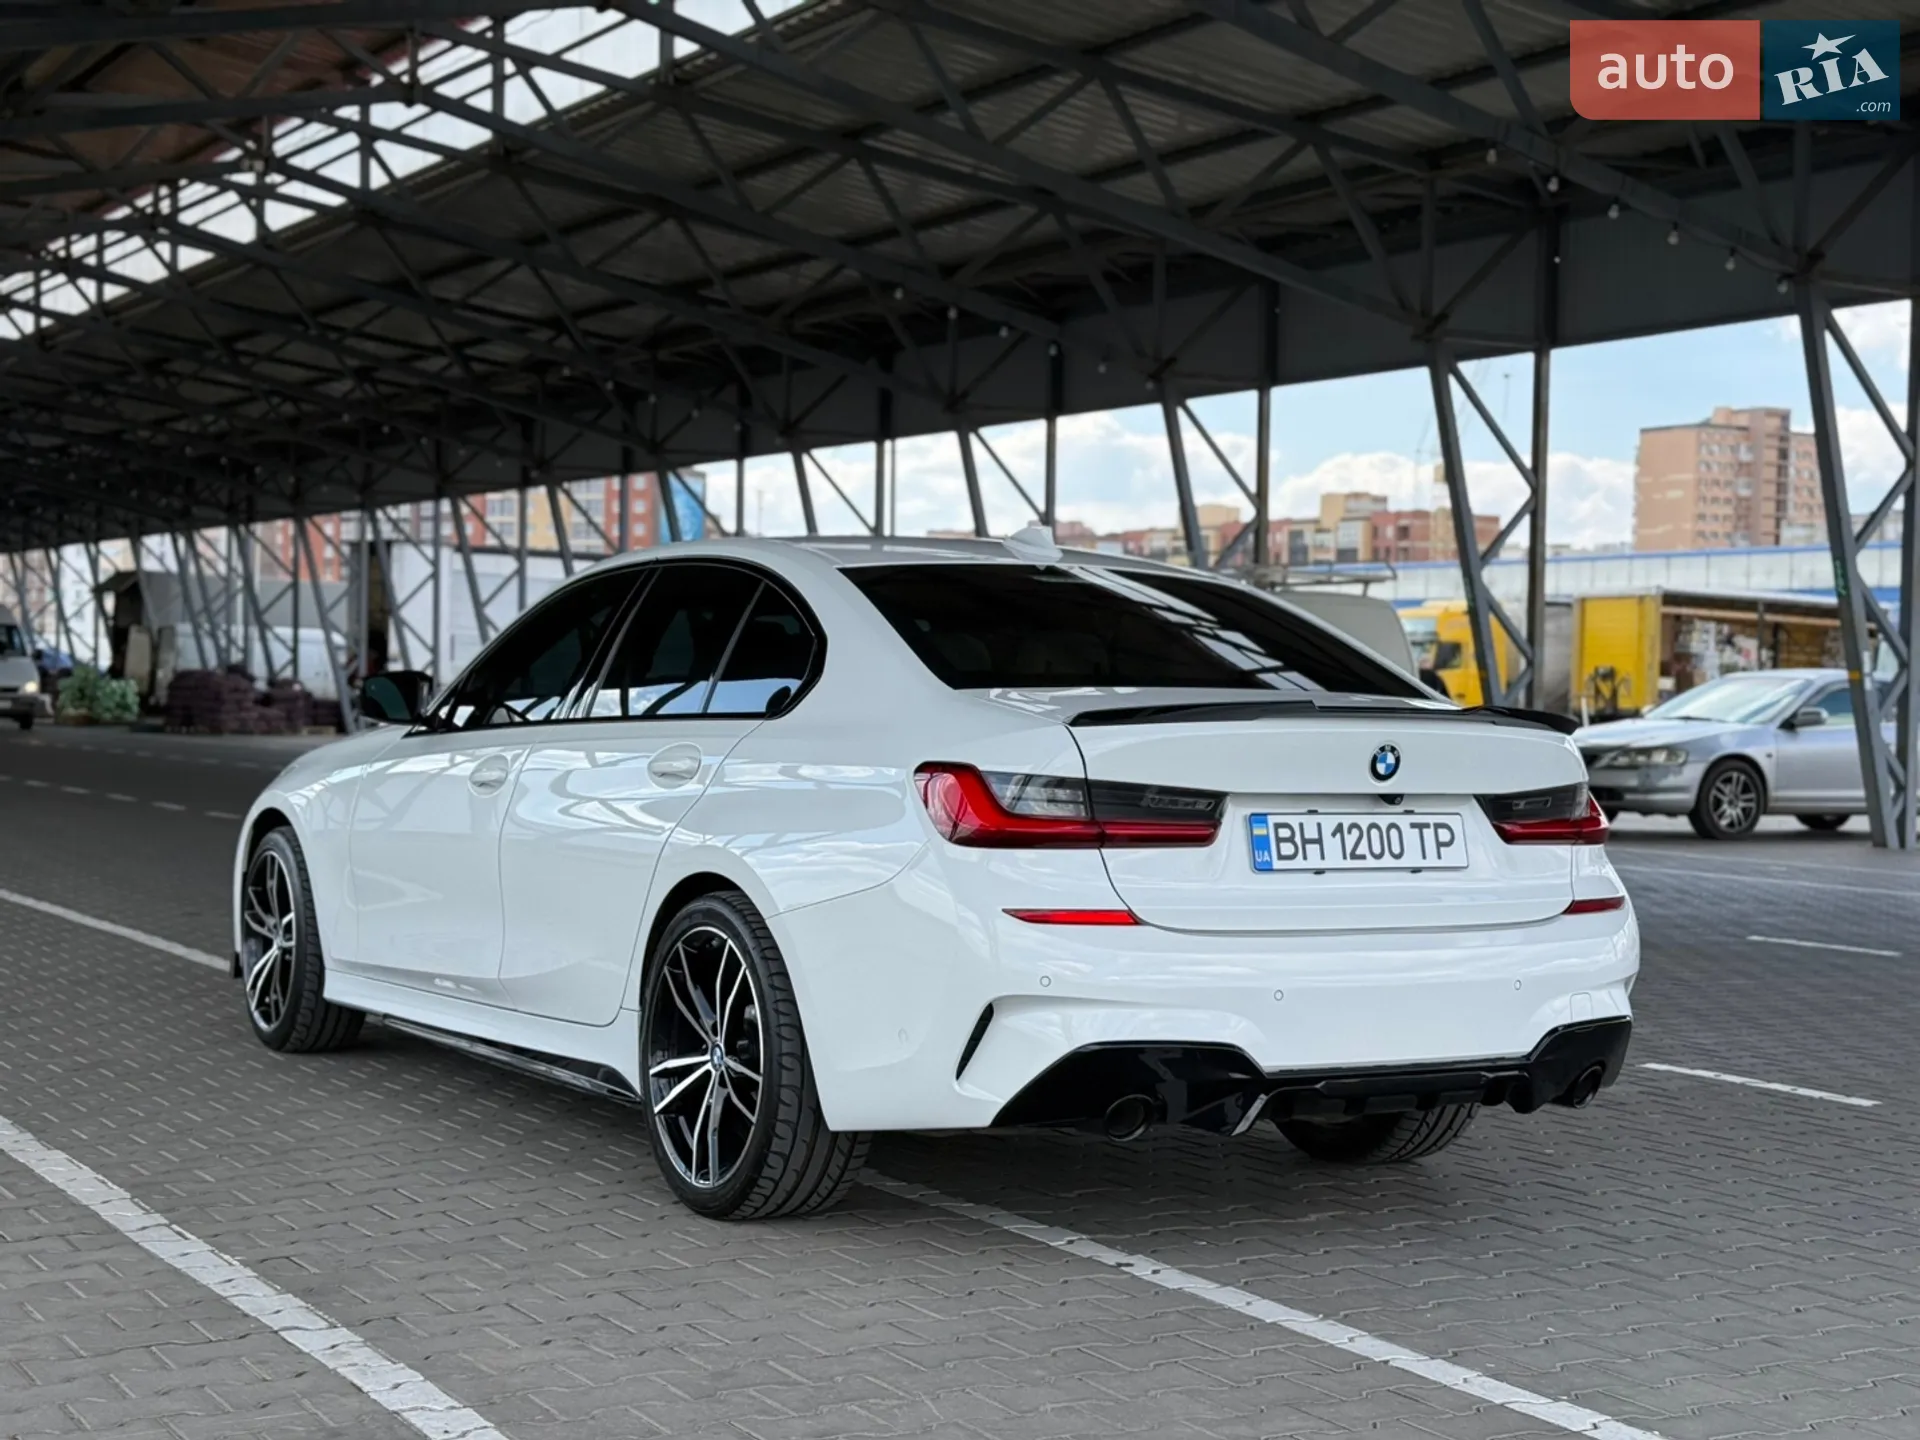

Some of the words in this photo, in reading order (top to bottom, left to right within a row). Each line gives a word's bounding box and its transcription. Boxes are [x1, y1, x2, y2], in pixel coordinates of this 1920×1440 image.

[1274, 822, 1325, 861] BH
[1331, 822, 1405, 860] 1200
[1410, 822, 1455, 860] TP
[1255, 850, 1271, 862] UA
